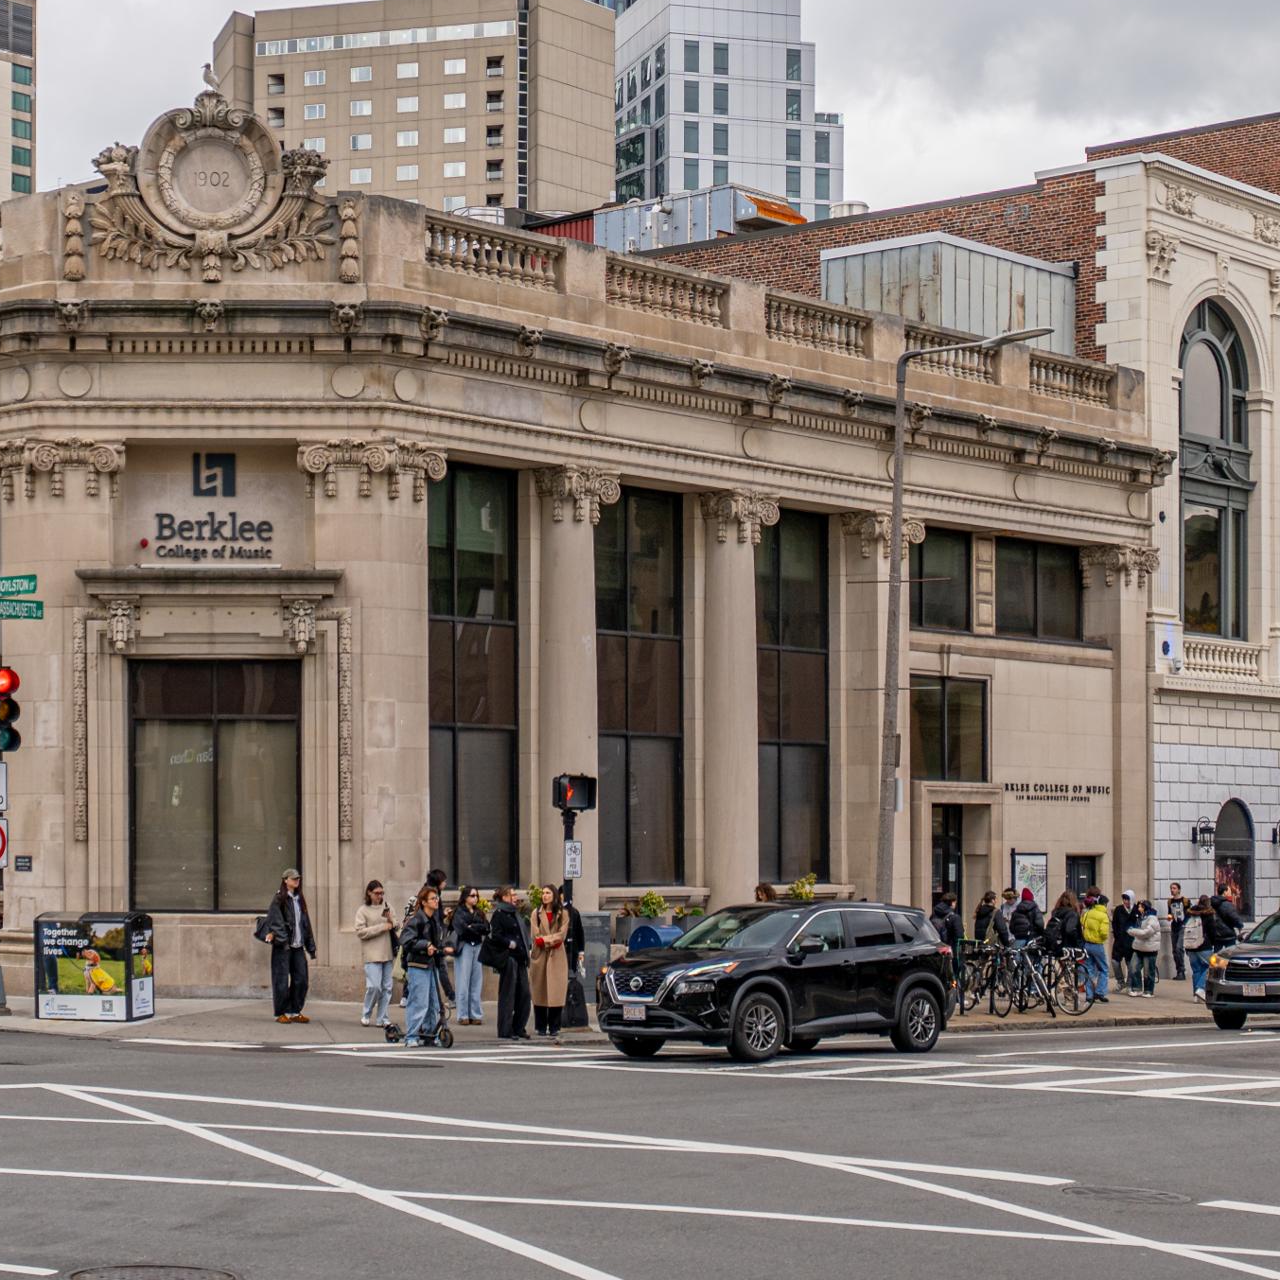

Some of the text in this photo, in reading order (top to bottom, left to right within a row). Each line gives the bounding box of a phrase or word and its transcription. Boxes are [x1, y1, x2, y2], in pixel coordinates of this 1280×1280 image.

[193, 171, 230, 188] 1902
[155, 511, 274, 542] Berklee
[156, 544, 273, 562] College of Music
[1033, 783, 1070, 794] COLLEGE
[1072, 785, 1083, 793] OF
[1085, 786, 1111, 795] MUSIC
[43, 927, 78, 938] Together
[56, 938, 90, 948] change
[43, 947, 63, 956] lives
